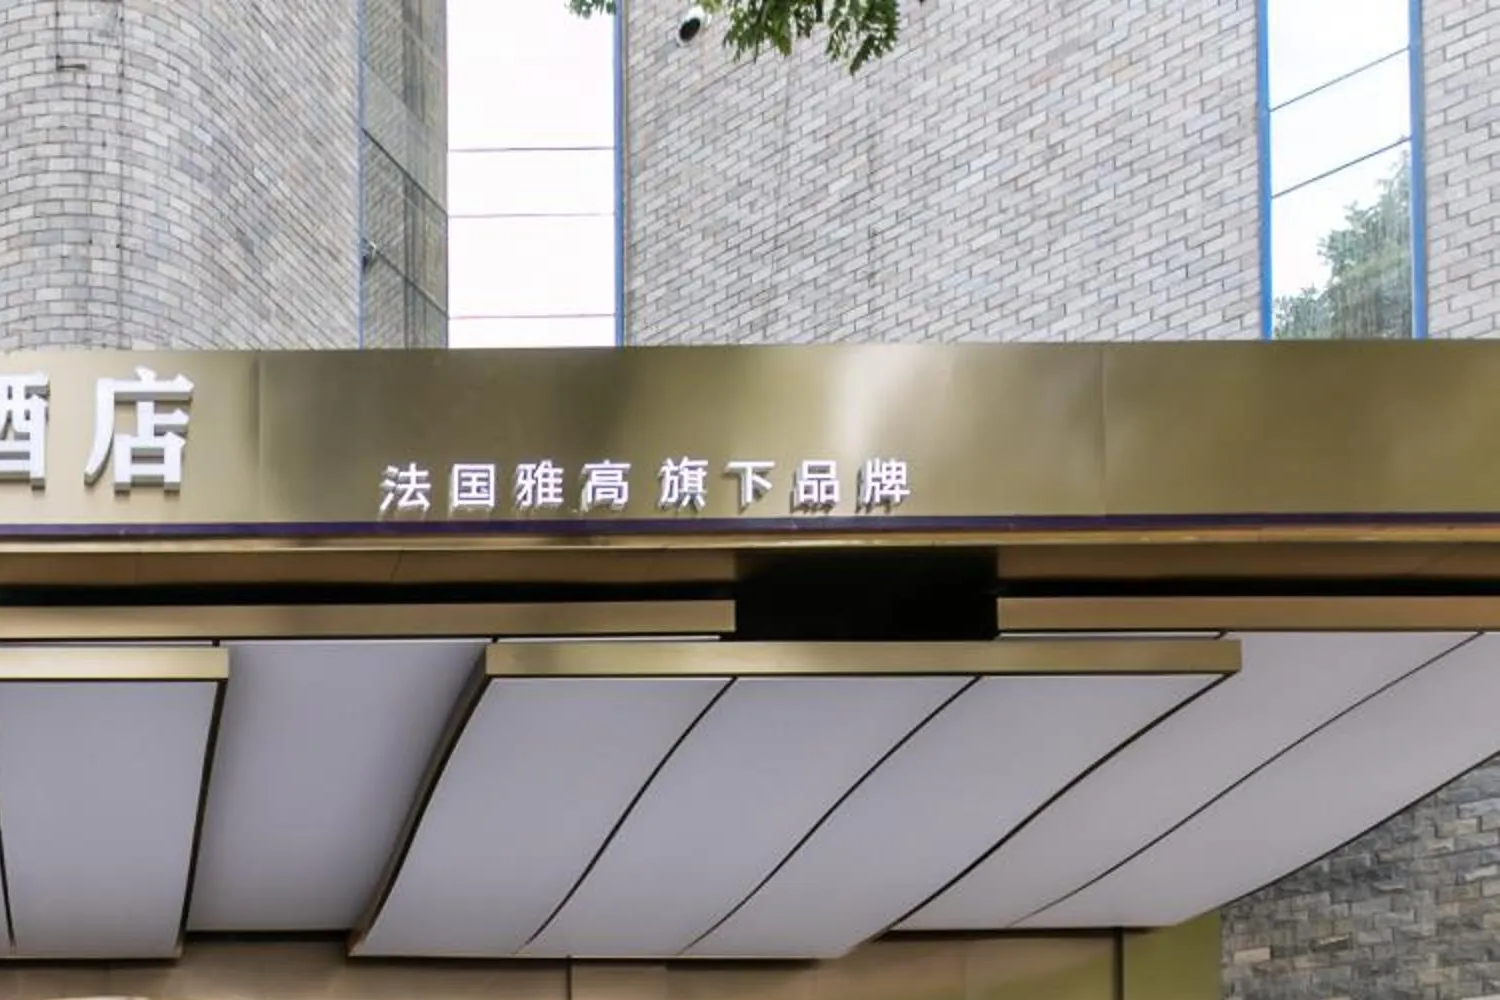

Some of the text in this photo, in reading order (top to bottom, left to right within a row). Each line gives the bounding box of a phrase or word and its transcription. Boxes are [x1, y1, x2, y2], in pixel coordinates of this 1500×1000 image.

[378, 456, 912, 512] 法国雅高旗下品牌
